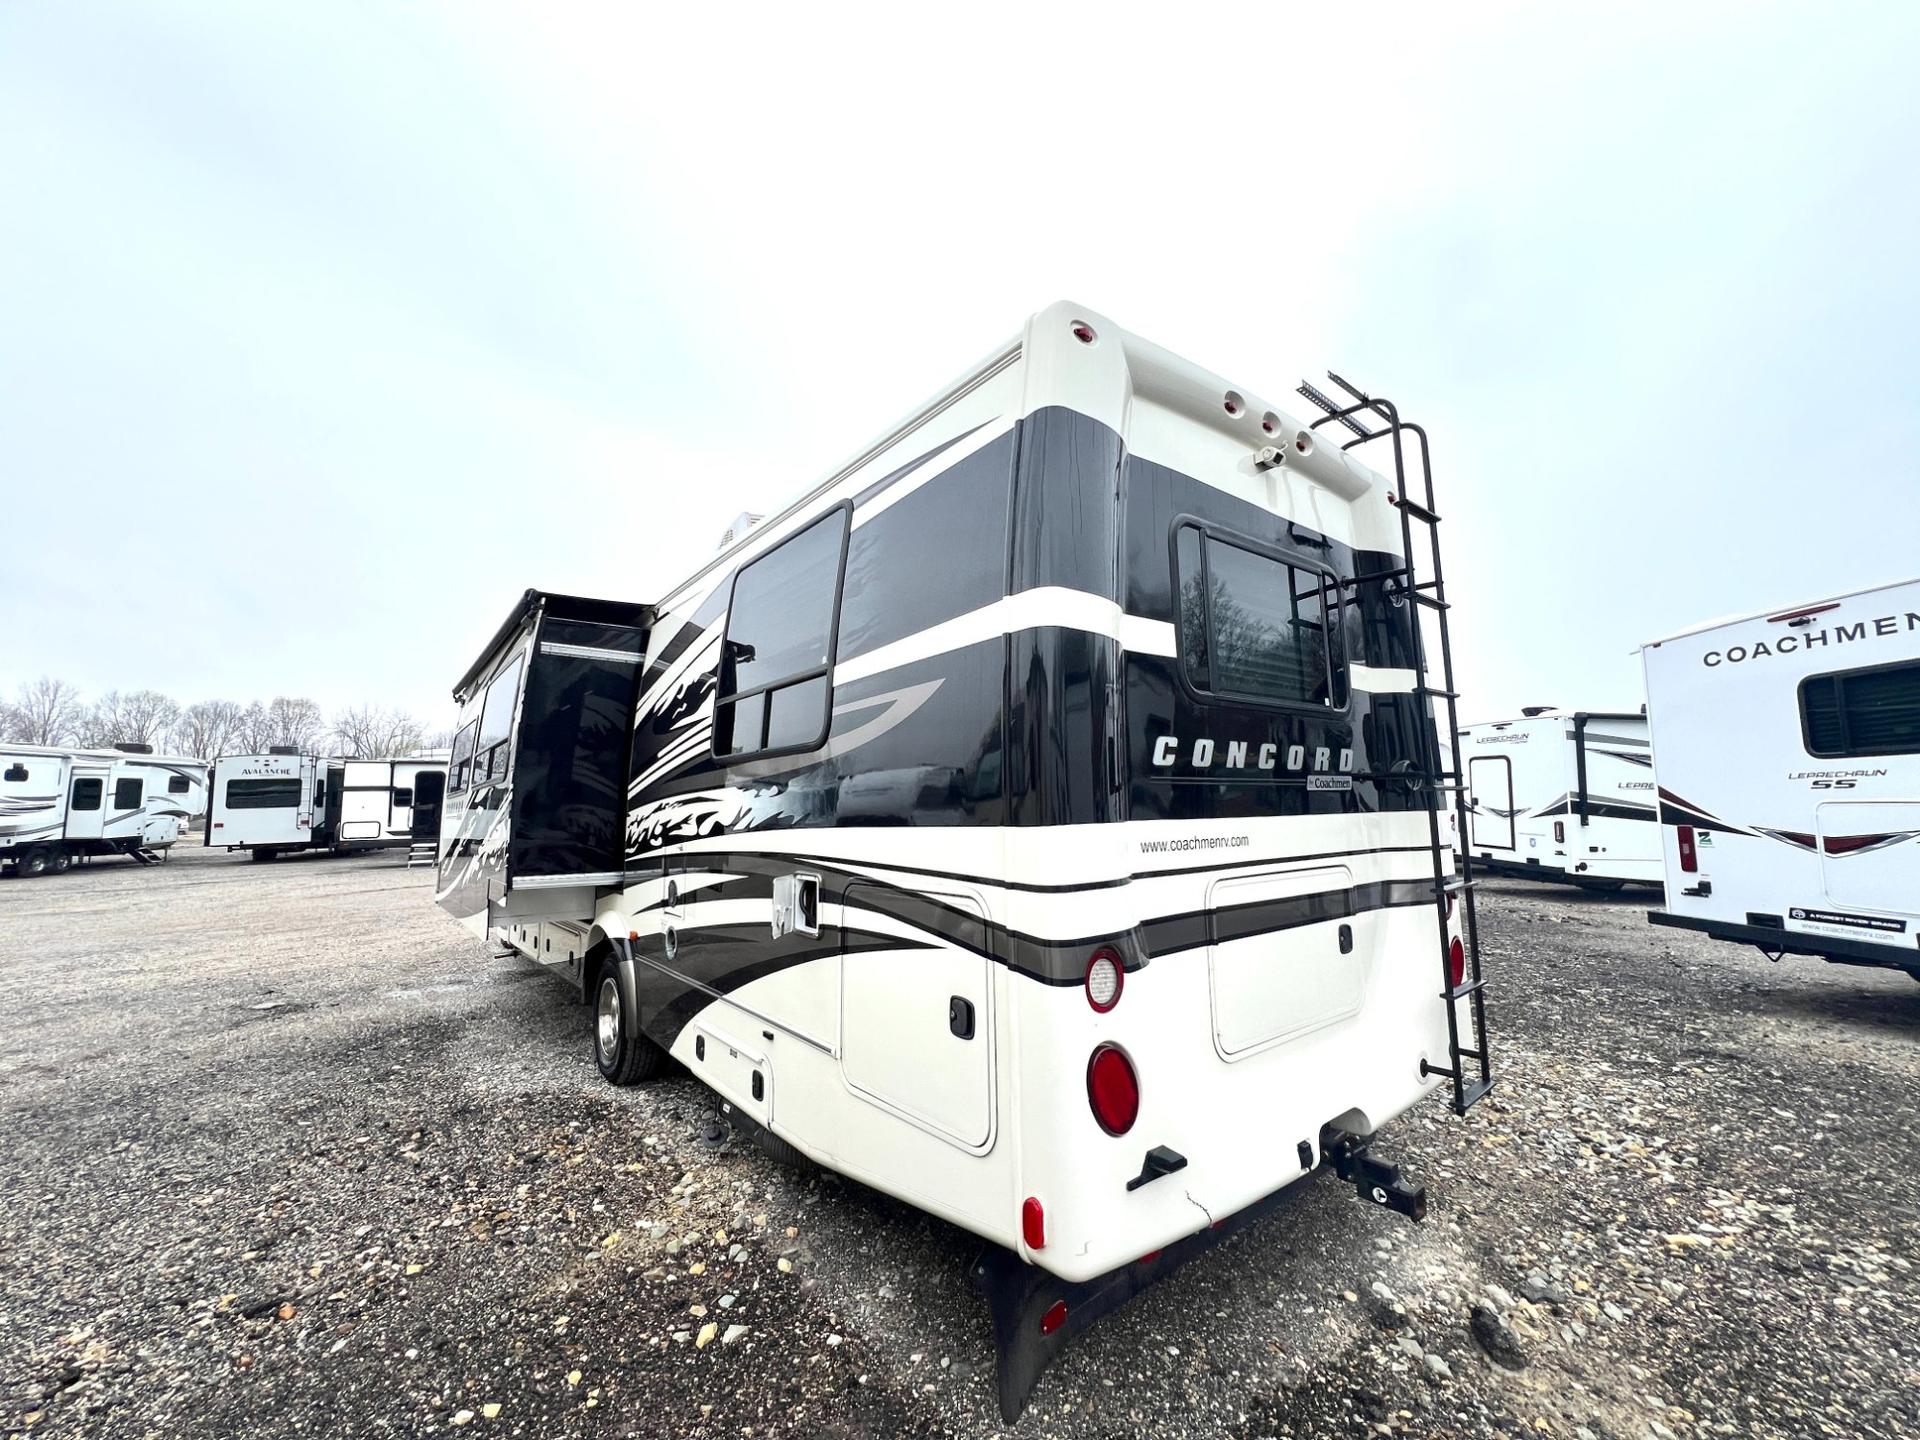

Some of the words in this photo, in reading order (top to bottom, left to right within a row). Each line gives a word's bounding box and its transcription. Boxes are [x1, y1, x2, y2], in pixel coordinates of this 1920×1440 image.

[1152, 736, 1355, 773] CONCORD
[1788, 769, 1888, 780] LEPRECHAUN
[1314, 777, 1351, 788] Coachmen
[1811, 779, 1858, 789] SS
[1140, 835, 1250, 853] www.coachmenrv.com
